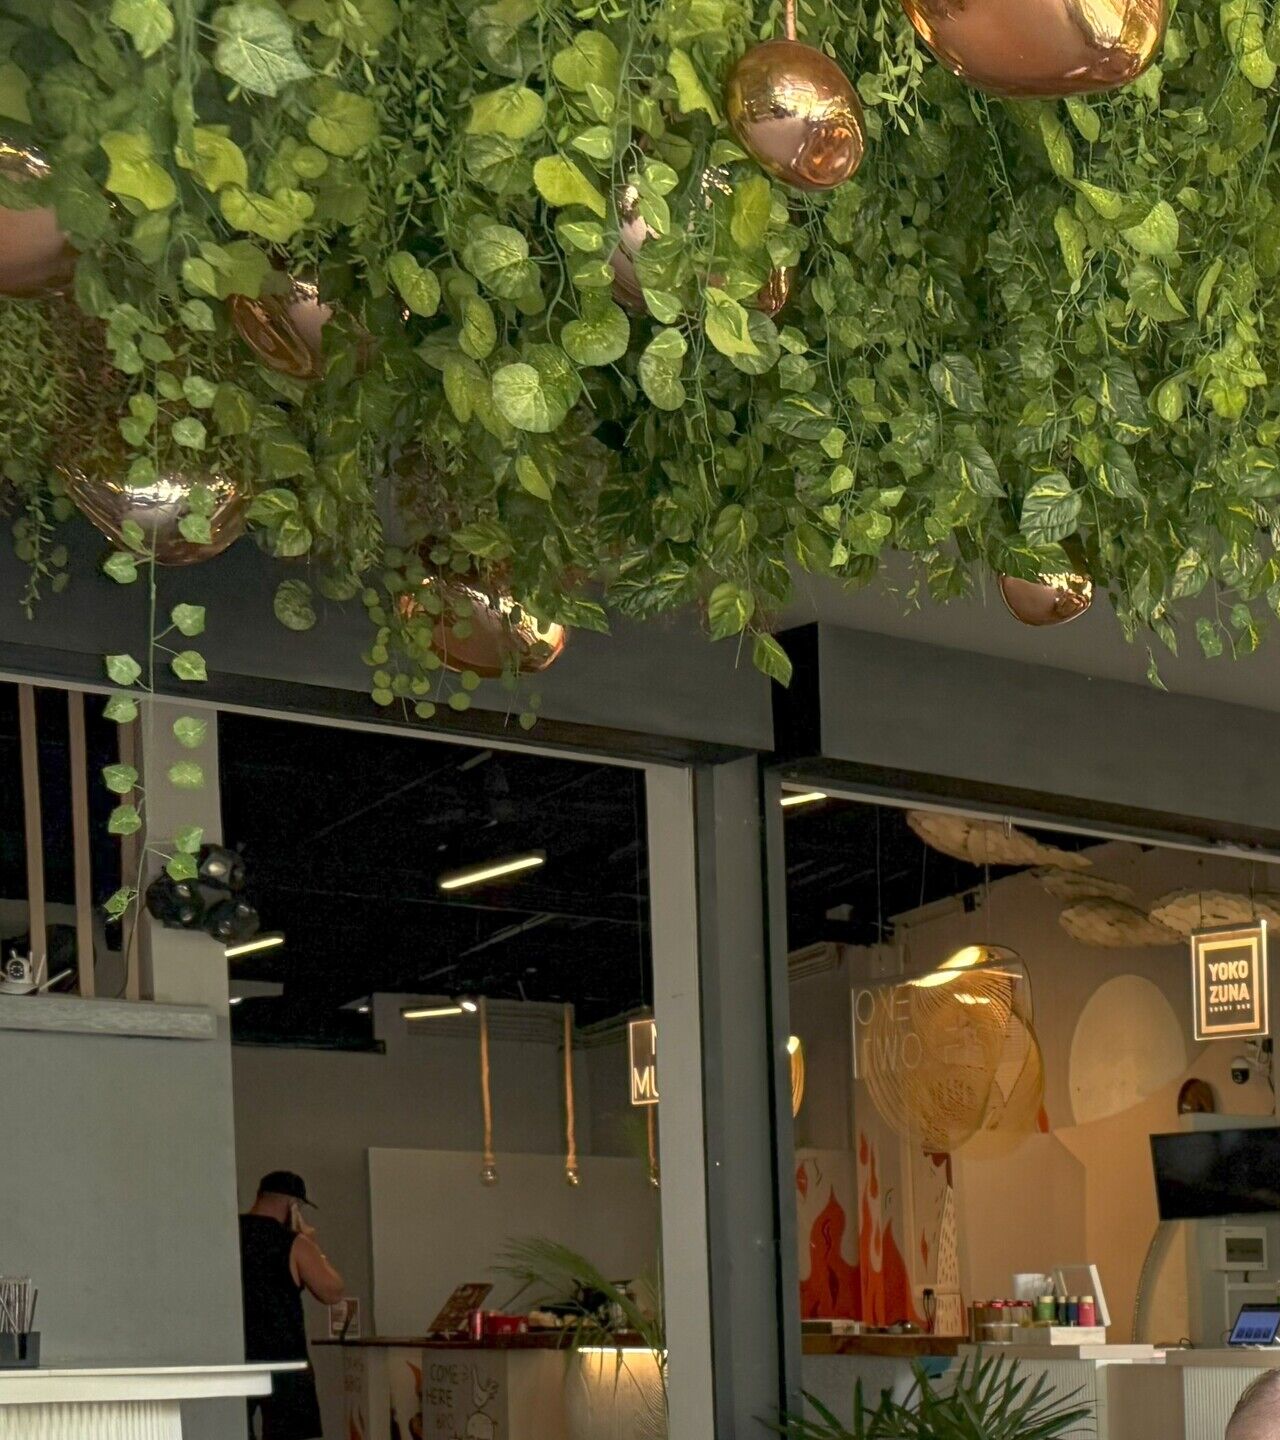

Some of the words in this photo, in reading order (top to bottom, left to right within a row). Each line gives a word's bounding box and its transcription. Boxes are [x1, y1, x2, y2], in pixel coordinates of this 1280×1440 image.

[1208, 960, 1249, 981] YOKO
[1209, 982, 1250, 1004] ZUNA
[426, 1387, 453, 1408] HERE
